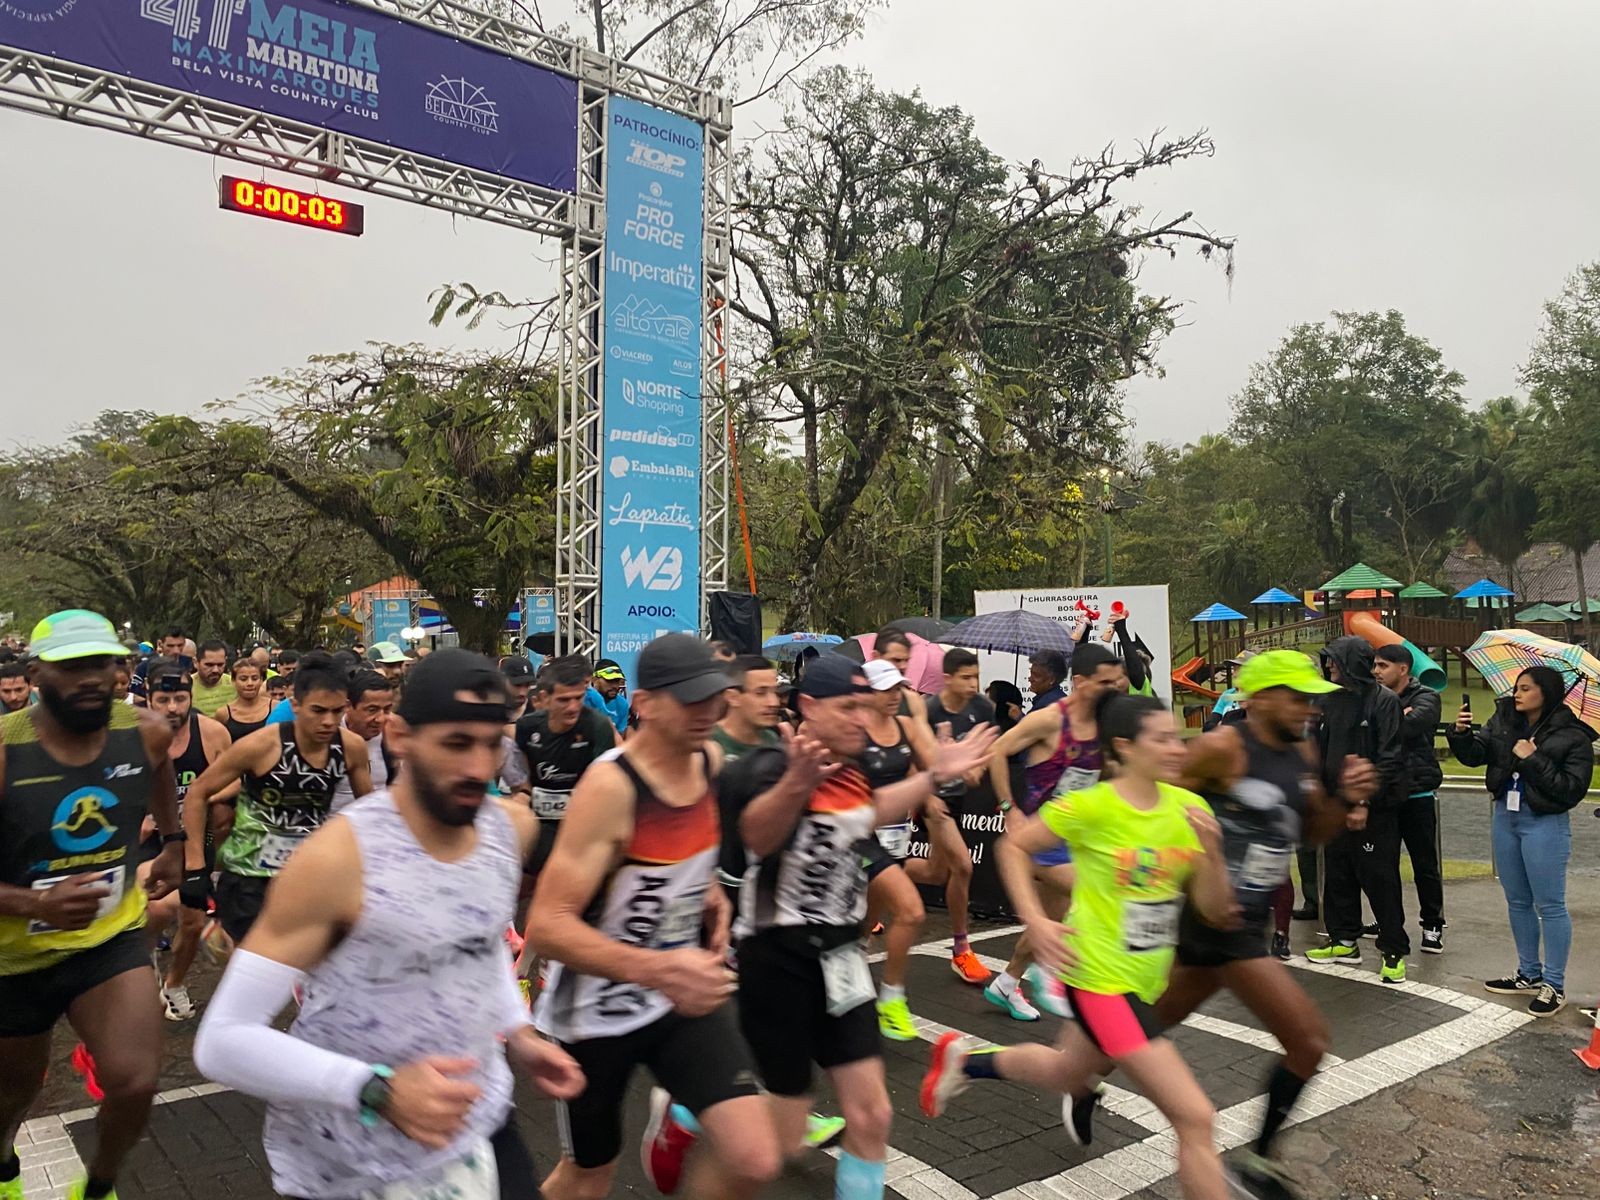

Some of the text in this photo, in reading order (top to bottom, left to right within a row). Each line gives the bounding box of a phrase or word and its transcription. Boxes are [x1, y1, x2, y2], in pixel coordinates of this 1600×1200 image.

[248, 0, 380, 72] MEIA
[172, 37, 379, 108] MAXIMARQUES
[247, 37, 379, 94] MARATONA
[172, 56, 379, 120] BELA VISTA COUNTRY CLUB
[433, 115, 490, 135] COUNTRY CLUB
[614, 114, 699, 151] PATROCÍNIO:
[629, 143, 687, 168] TOP
[236, 181, 343, 224] 0:00:03
[636, 204, 674, 228] PRO
[624, 219, 685, 250] FORCE
[610, 250, 696, 290] Imperatriz
[615, 310, 650, 331] alto
[653, 320, 690, 340] vale
[636, 380, 682, 399] NORTE
[636, 395, 684, 417] Shopping
[631, 460, 695, 478] EmbalaBlu
[621, 544, 683, 591] WB
[627, 605, 676, 618] APOIO:
[1028, 594, 1098, 603] CHURRASQUEIRA
